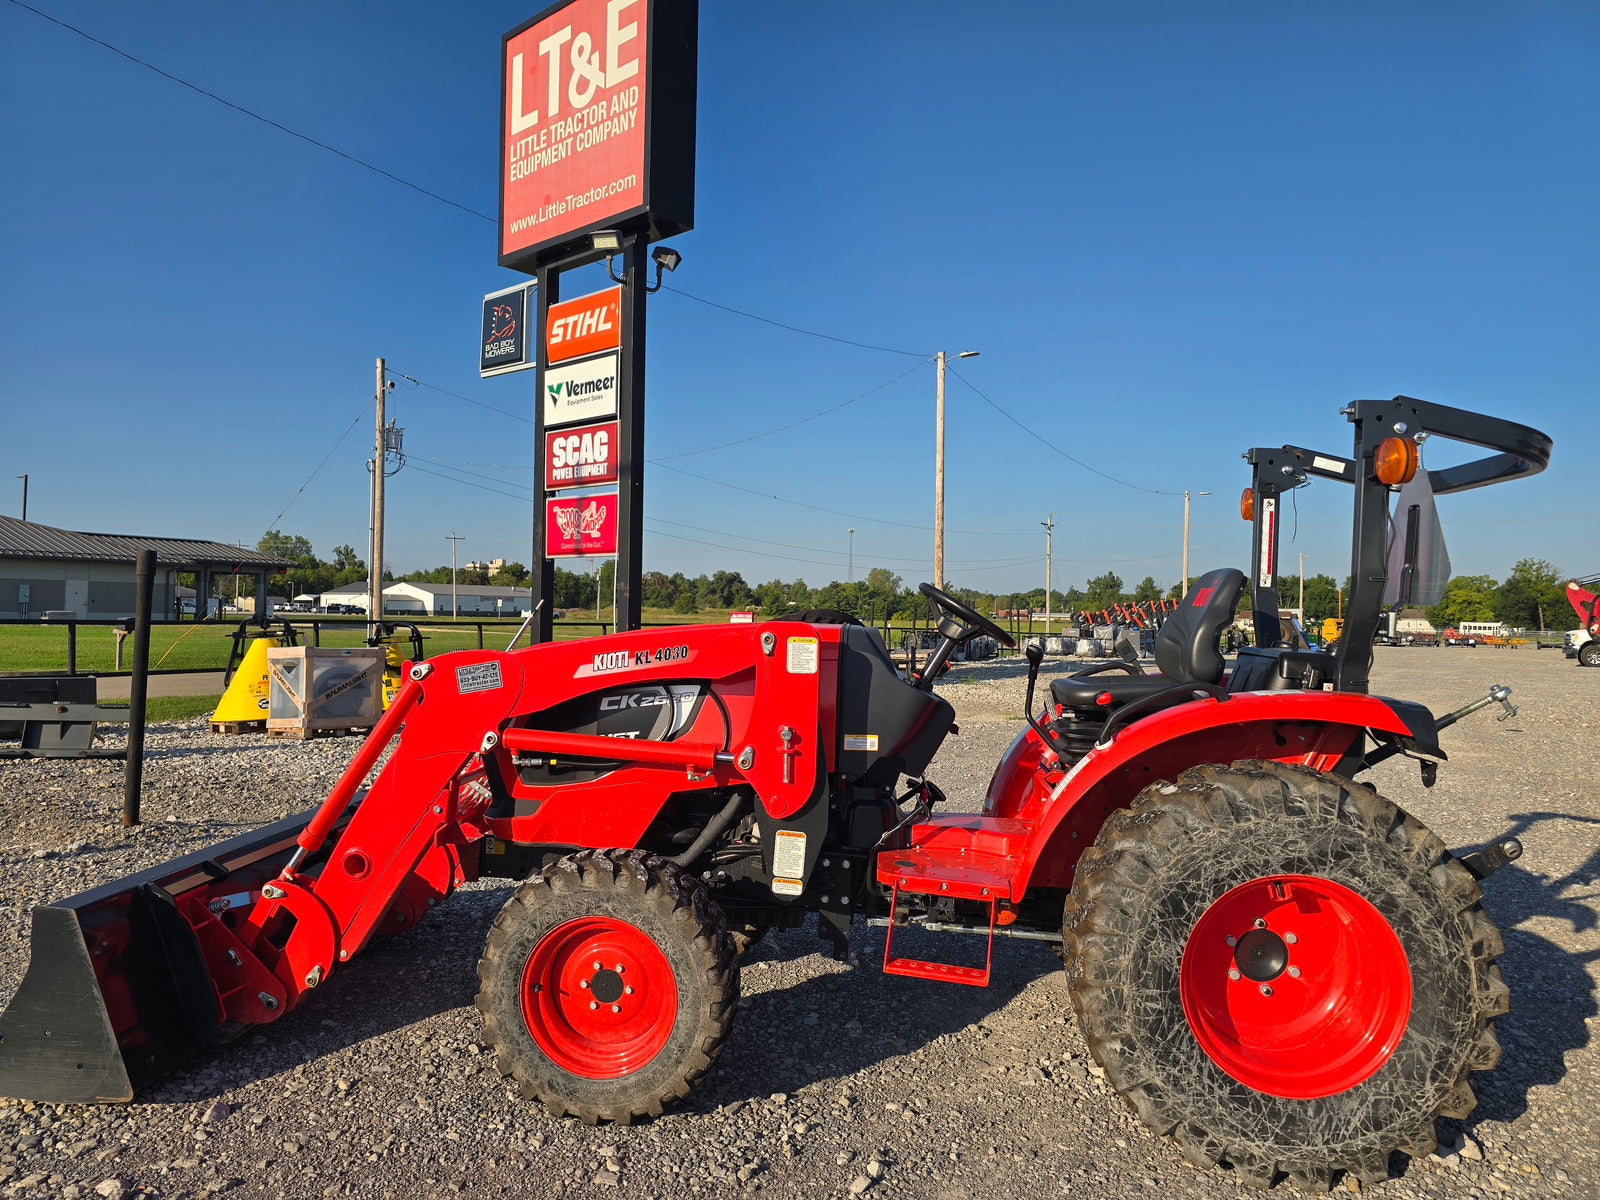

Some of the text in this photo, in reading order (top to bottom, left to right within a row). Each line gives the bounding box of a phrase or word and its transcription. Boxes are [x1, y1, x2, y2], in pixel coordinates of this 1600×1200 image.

[511, 0, 639, 136] LT&E
[510, 85, 639, 163] LITTLE TRACTOR AND
[510, 108, 638, 182] EQUIPMENT COMPANY
[510, 173, 636, 234] www.LittleTractor.com
[550, 306, 612, 345] STIHL
[485, 338, 515, 352] BAD BOY
[485, 345, 515, 359] MOWERS
[566, 376, 615, 398] Vermeer
[567, 394, 603, 406] Equipment Sales
[552, 430, 608, 468] SCAG
[552, 462, 608, 480] POWER EQUIPMENT
[593, 645, 688, 672] KIOTI KL 4030
[324, 672, 368, 700] BAUMALIGHT
